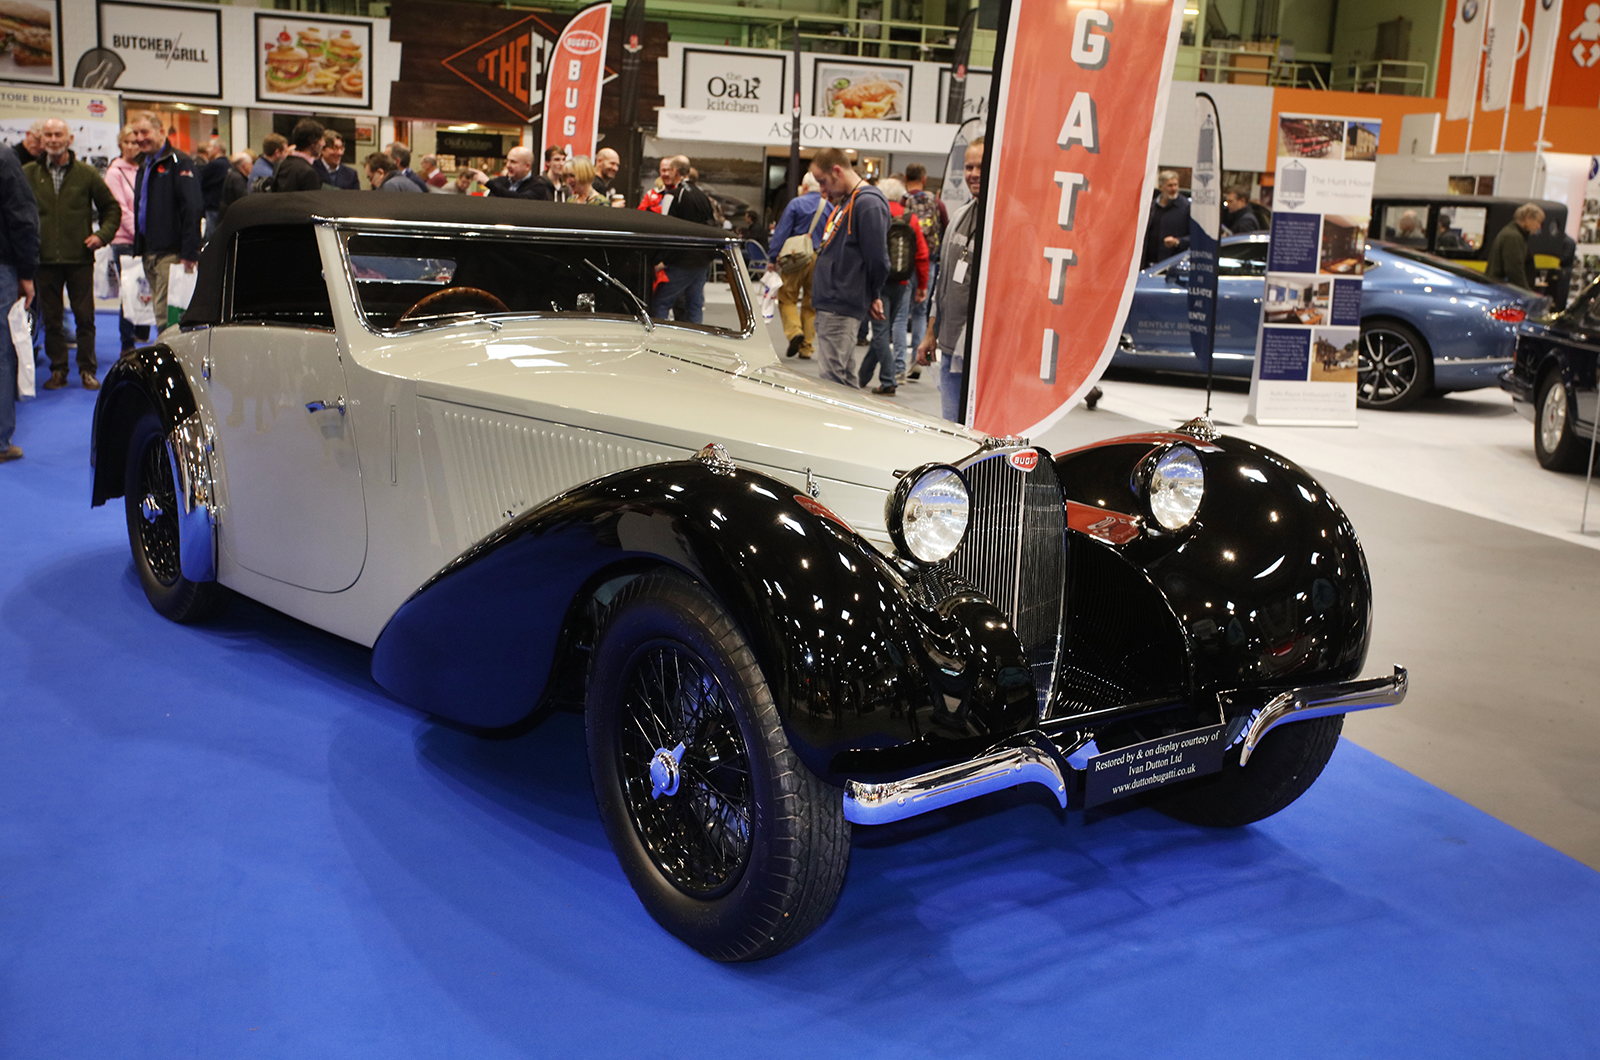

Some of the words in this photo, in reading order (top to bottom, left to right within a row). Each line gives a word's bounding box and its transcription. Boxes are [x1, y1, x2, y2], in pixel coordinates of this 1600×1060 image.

[113, 34, 173, 51] BUTCHER
[567, 37, 597, 49] BUGATTI
[172, 48, 208, 63] GRILL
[726, 72, 742, 81] the
[707, 76, 761, 100] Oak
[33, 94, 80, 106] BUGATTI
[706, 99, 760, 114] kitchen
[768, 122, 834, 140] ASON
[839, 126, 913, 144] MARTIN
[1138, 320, 1175, 330] BENTLEY
[1095, 756, 1125, 771] Restored
[1126, 752, 1136, 764] by
[1136, 750, 1144, 760] &
[1144, 748, 1155, 757] on
[1155, 740, 1180, 755] display
[1181, 735, 1210, 749] courtesy
[1211, 730, 1221, 741] of
[1128, 764, 1144, 776] Ivan
[1145, 757, 1169, 771] Dutton
[1170, 752, 1183, 764] Ltd
[1112, 763, 1196, 795] www.duttonbugatti.co.uk
